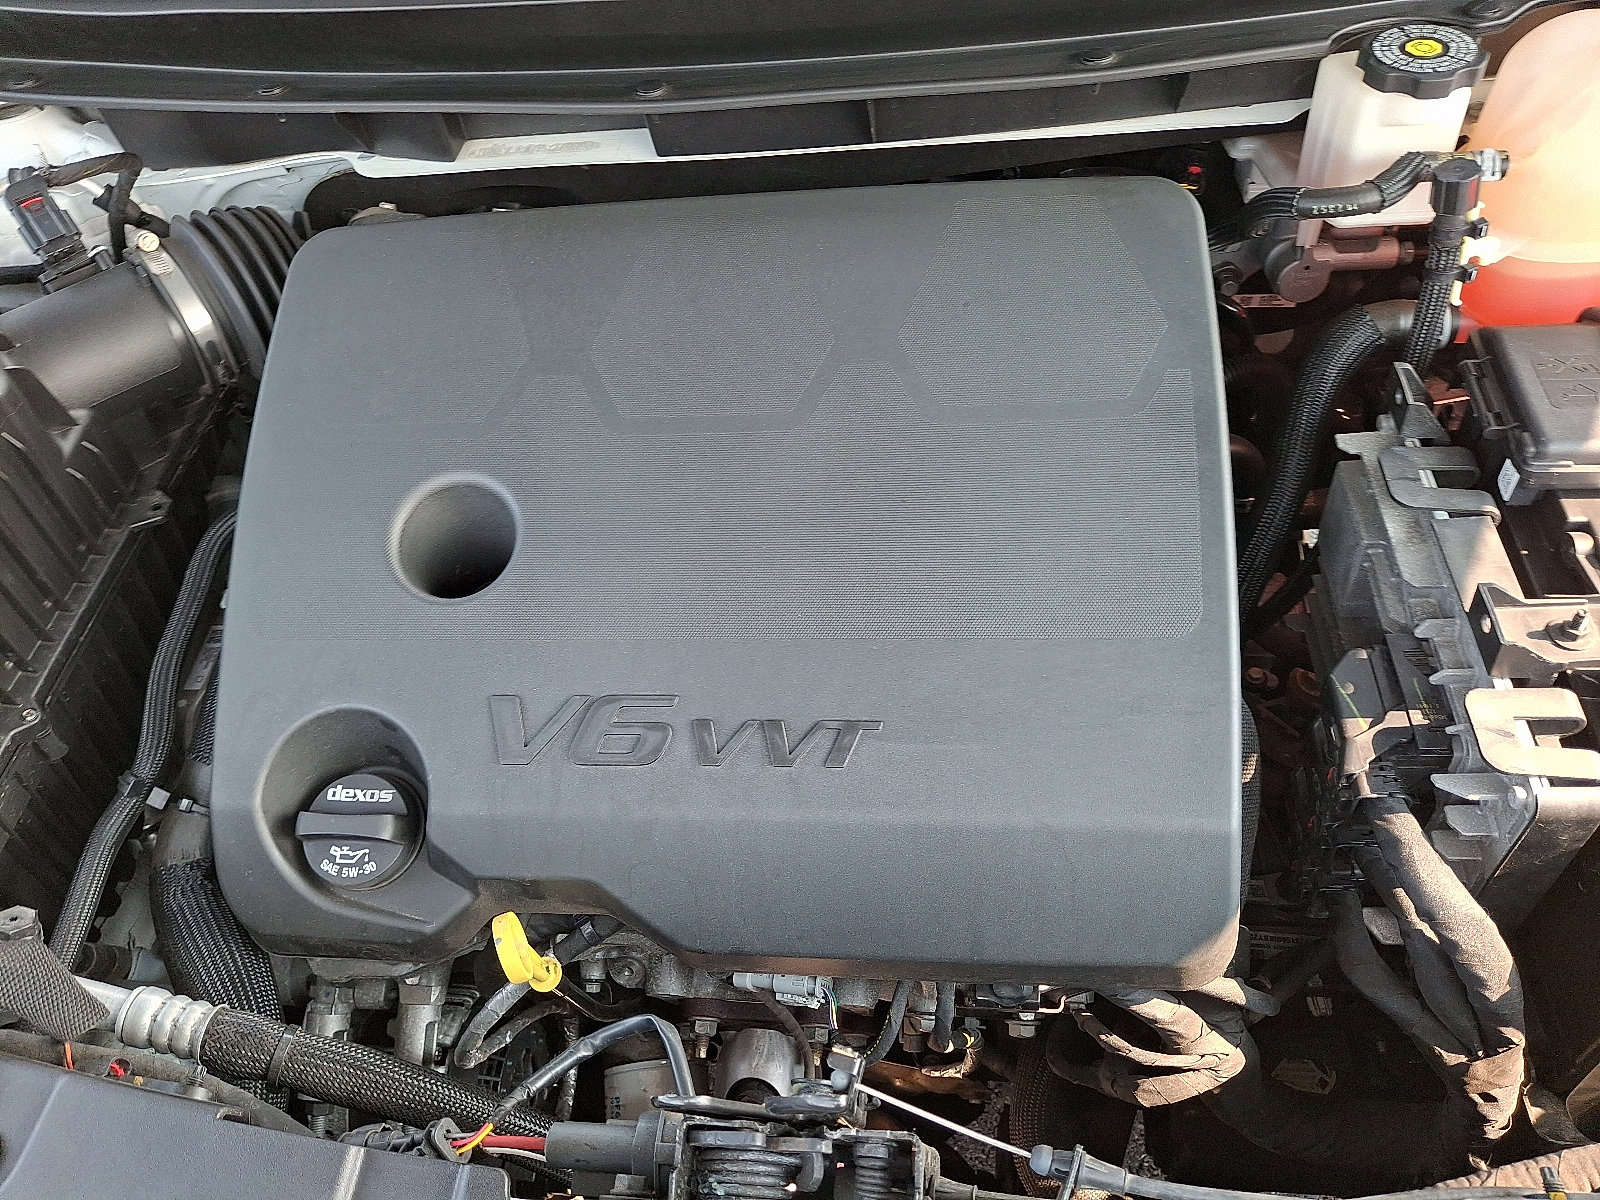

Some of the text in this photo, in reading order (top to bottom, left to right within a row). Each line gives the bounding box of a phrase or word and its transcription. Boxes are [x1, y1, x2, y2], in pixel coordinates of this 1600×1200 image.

[488, 694, 884, 769] V6 VVT
[326, 784, 397, 803] dexos
[320, 858, 378, 878] SAE 5W-30
